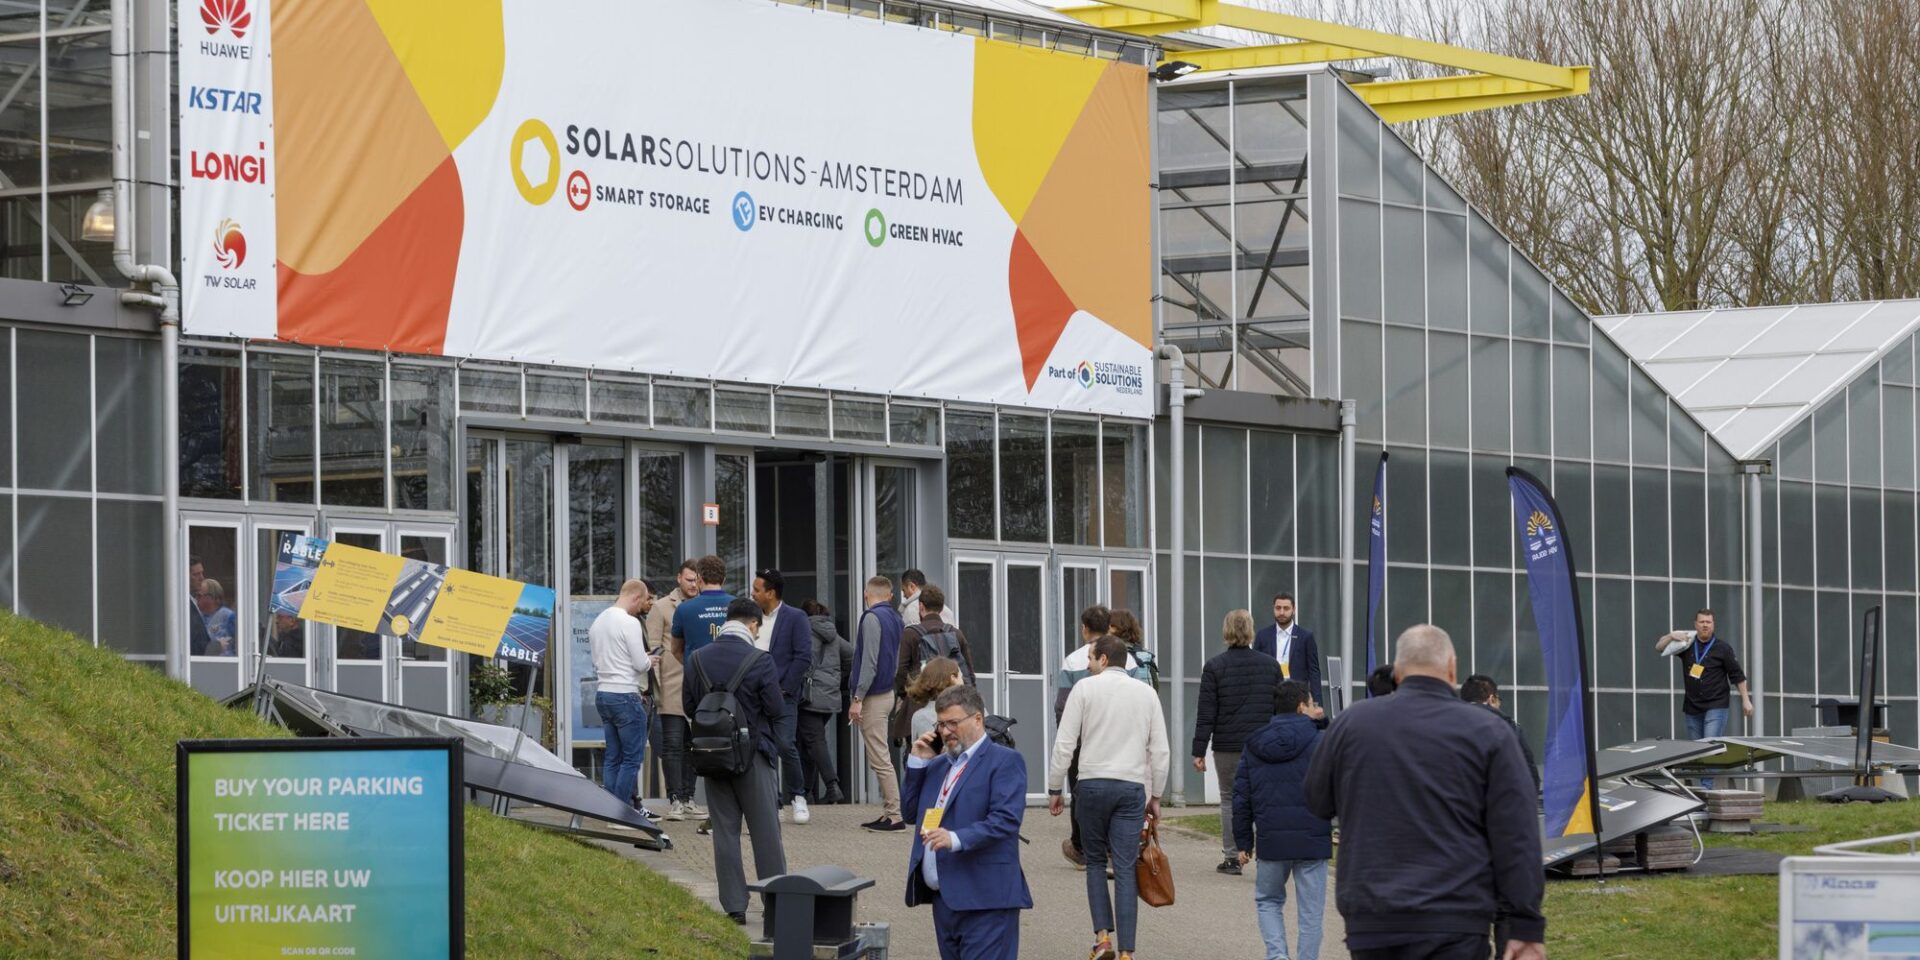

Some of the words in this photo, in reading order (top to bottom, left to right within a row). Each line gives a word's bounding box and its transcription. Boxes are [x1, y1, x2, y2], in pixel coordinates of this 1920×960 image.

[200, 40, 253, 60] HUAWEI
[189, 86, 262, 115] KSTAR
[596, 185, 644, 206] SMART
[650, 192, 710, 214] STORAGE
[759, 205, 775, 221] EV
[778, 208, 843, 231] CHARGING
[890, 223, 929, 243] GREEN
[932, 230, 963, 247] HVAC
[204, 275, 221, 288] TW
[224, 277, 256, 290] SOLAR
[1049, 366, 1066, 379] Part
[1067, 367, 1076, 380] of
[1094, 362, 1142, 376] SUSTAINABLE
[1095, 373, 1143, 388] SOLUTIONS
[1116, 387, 1143, 395] NEDERLAND
[214, 778, 258, 797] BUY
[262, 777, 323, 796] YOUR
[328, 776, 423, 795] PARKING
[214, 812, 288, 831] TICKET
[294, 812, 350, 830] HERE
[214, 869, 274, 888] KOOP
[280, 869, 328, 888] HIER
[334, 869, 371, 887] UW
[214, 904, 356, 924] UITRIJKAART
[281, 946, 304, 955] SCAN
[332, 946, 356, 955] CODE
